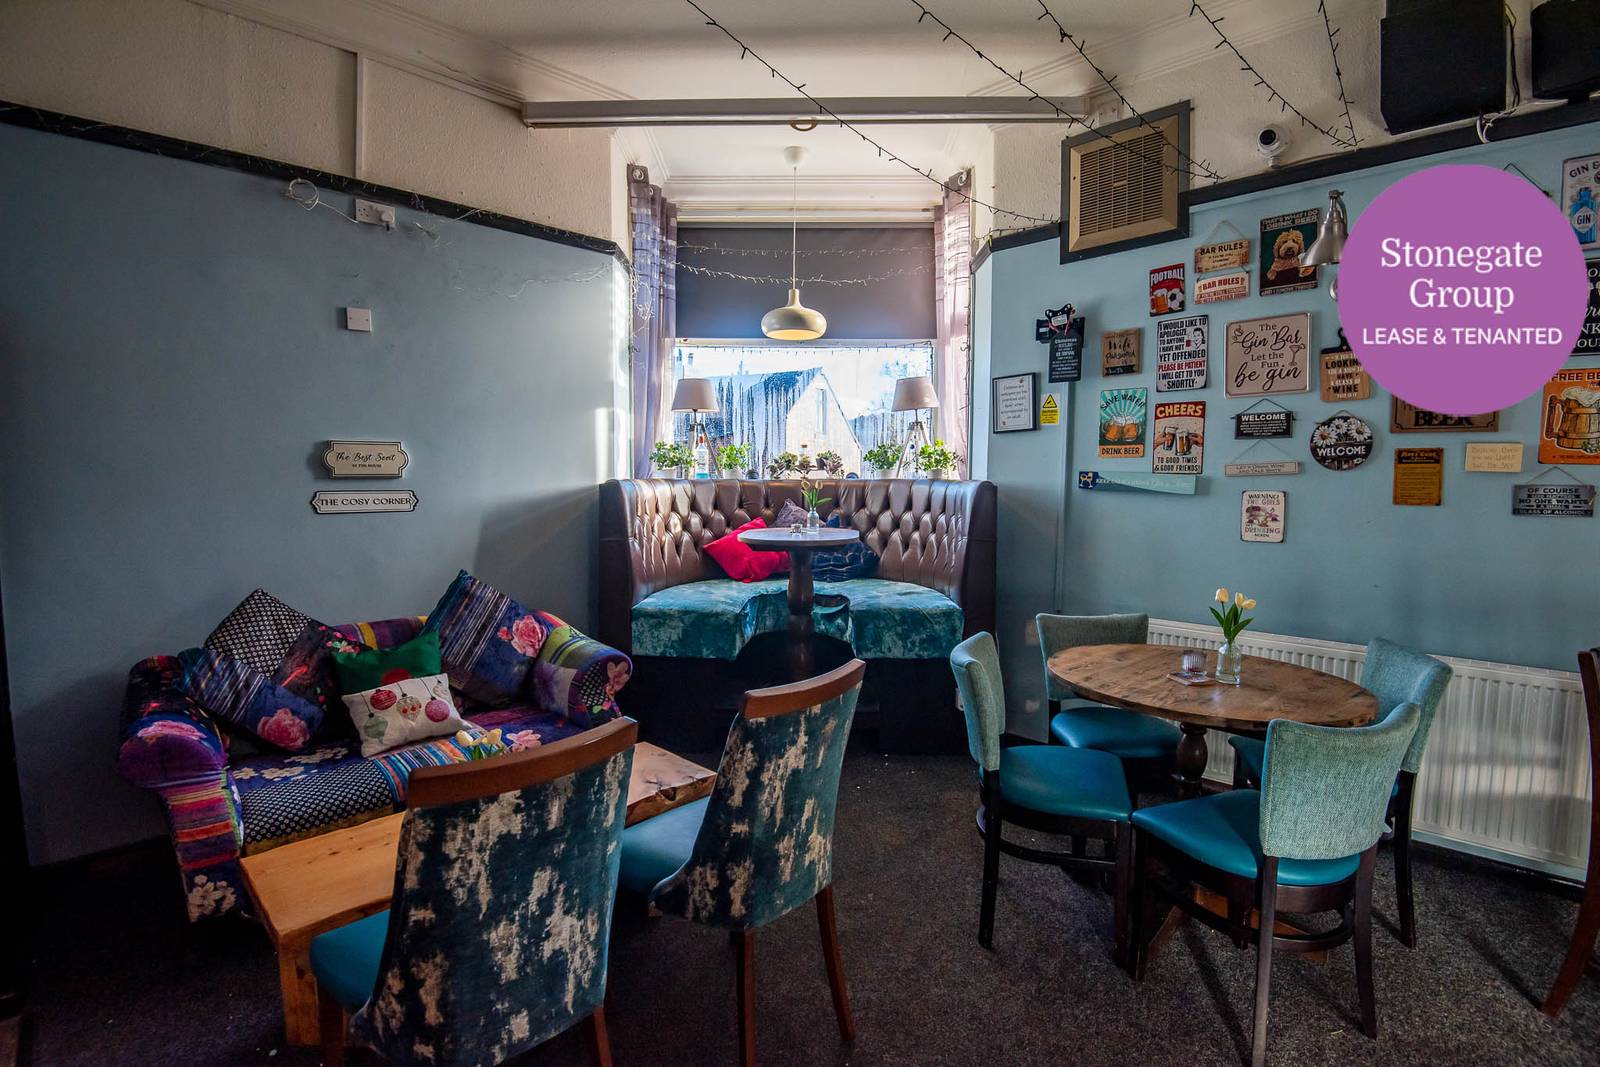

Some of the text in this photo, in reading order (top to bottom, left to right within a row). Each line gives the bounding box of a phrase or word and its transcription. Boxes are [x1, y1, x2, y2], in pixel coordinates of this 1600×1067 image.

[1569, 163, 1590, 178] GIN
[1576, 213, 1591, 225] GIN
[1200, 241, 1244, 256] BAR RULES
[1151, 268, 1185, 286] FOOTBALL
[1202, 277, 1240, 291] BAR RULES
[1163, 320, 1184, 331] WOULD
[1185, 319, 1198, 328] LIKE
[1199, 317, 1207, 326] TO
[1259, 323, 1277, 332] The
[1160, 329, 1187, 339] APOLOGIZE
[1166, 337, 1185, 345] ANYONE
[1232, 325, 1302, 355] Gin Bar
[1162, 344, 1174, 352] HAVE
[1159, 349, 1206, 362] YET OFFENDED
[1251, 351, 1285, 361] Let the
[1158, 363, 1177, 372] PLEASE
[1185, 361, 1206, 369] PATIENT
[1261, 361, 1280, 369] Fun
[1325, 359, 1361, 370] LOOKIN
[1162, 372, 1174, 380] WILL
[1175, 371, 1185, 379] GET
[1186, 370, 1194, 378] TO
[1194, 369, 1206, 377] YOU
[1235, 362, 1301, 391] be gin
[1167, 379, 1196, 389] SHORTLY
[1332, 384, 1359, 394] WINE
[1100, 394, 1145, 409] SAVE WATER
[1156, 404, 1204, 417] CHEERS
[1241, 413, 1287, 422] WELCOME
[1101, 446, 1140, 455] DRINK BEER
[1317, 446, 1366, 457] WELCOME
[336, 452, 396, 462] The Best Seat
[342, 498, 370, 506] COSY
[373, 497, 411, 506] CORNER
